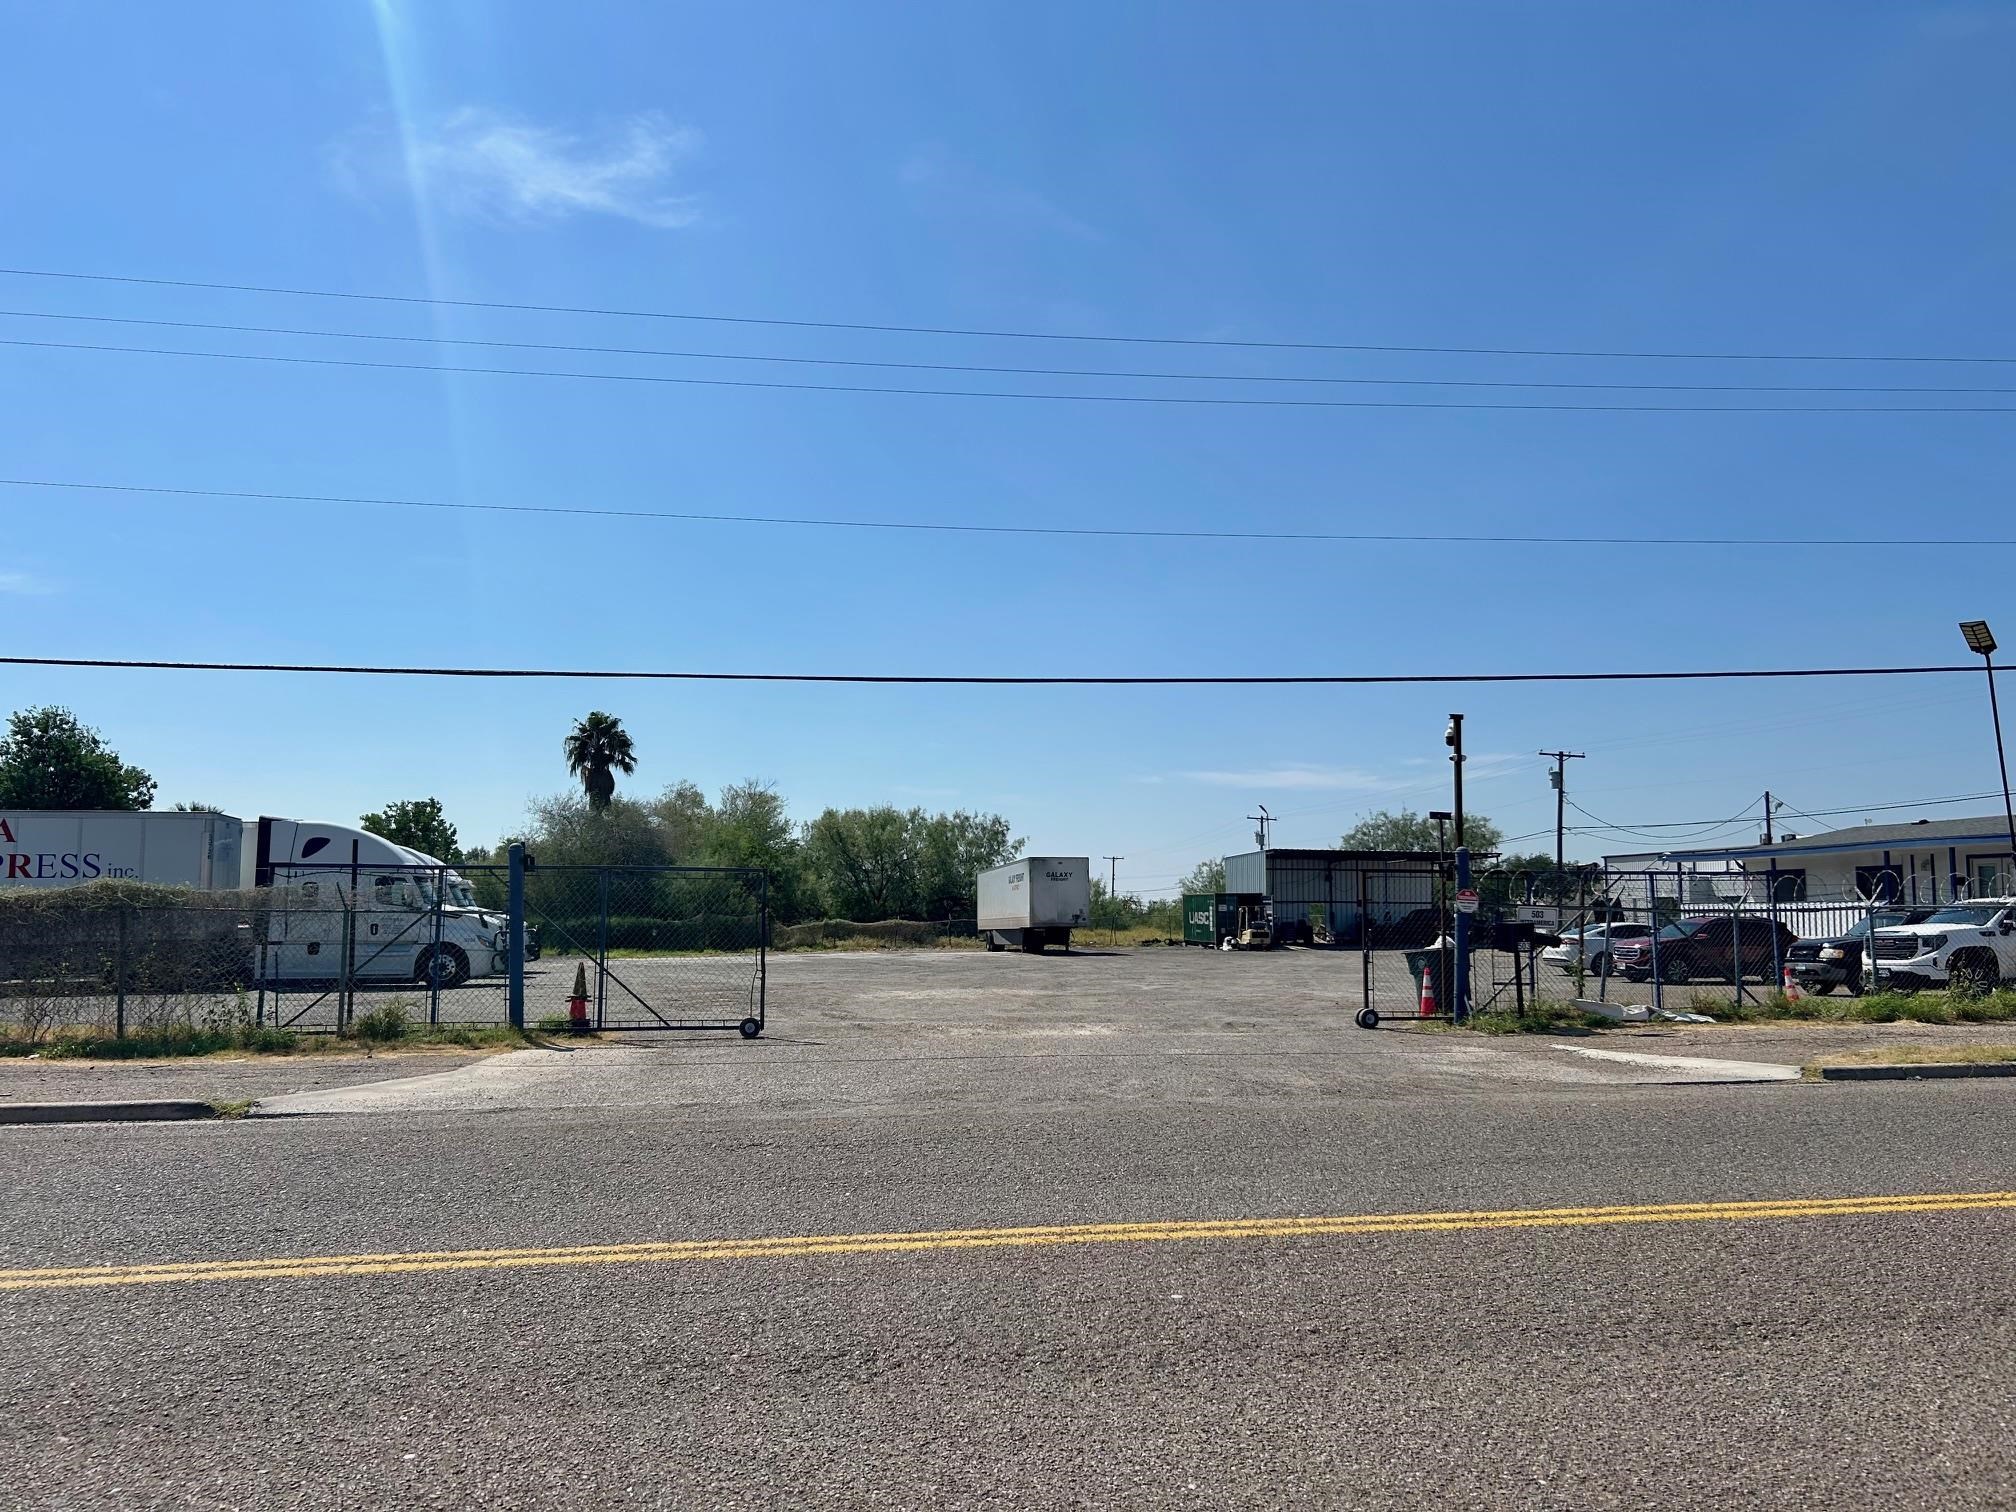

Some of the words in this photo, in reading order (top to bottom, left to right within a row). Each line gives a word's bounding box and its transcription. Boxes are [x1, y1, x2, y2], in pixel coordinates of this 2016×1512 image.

[0, 853, 101, 878] RESS
[107, 863, 139, 878] inc.
[1531, 911, 1544, 919] 503
